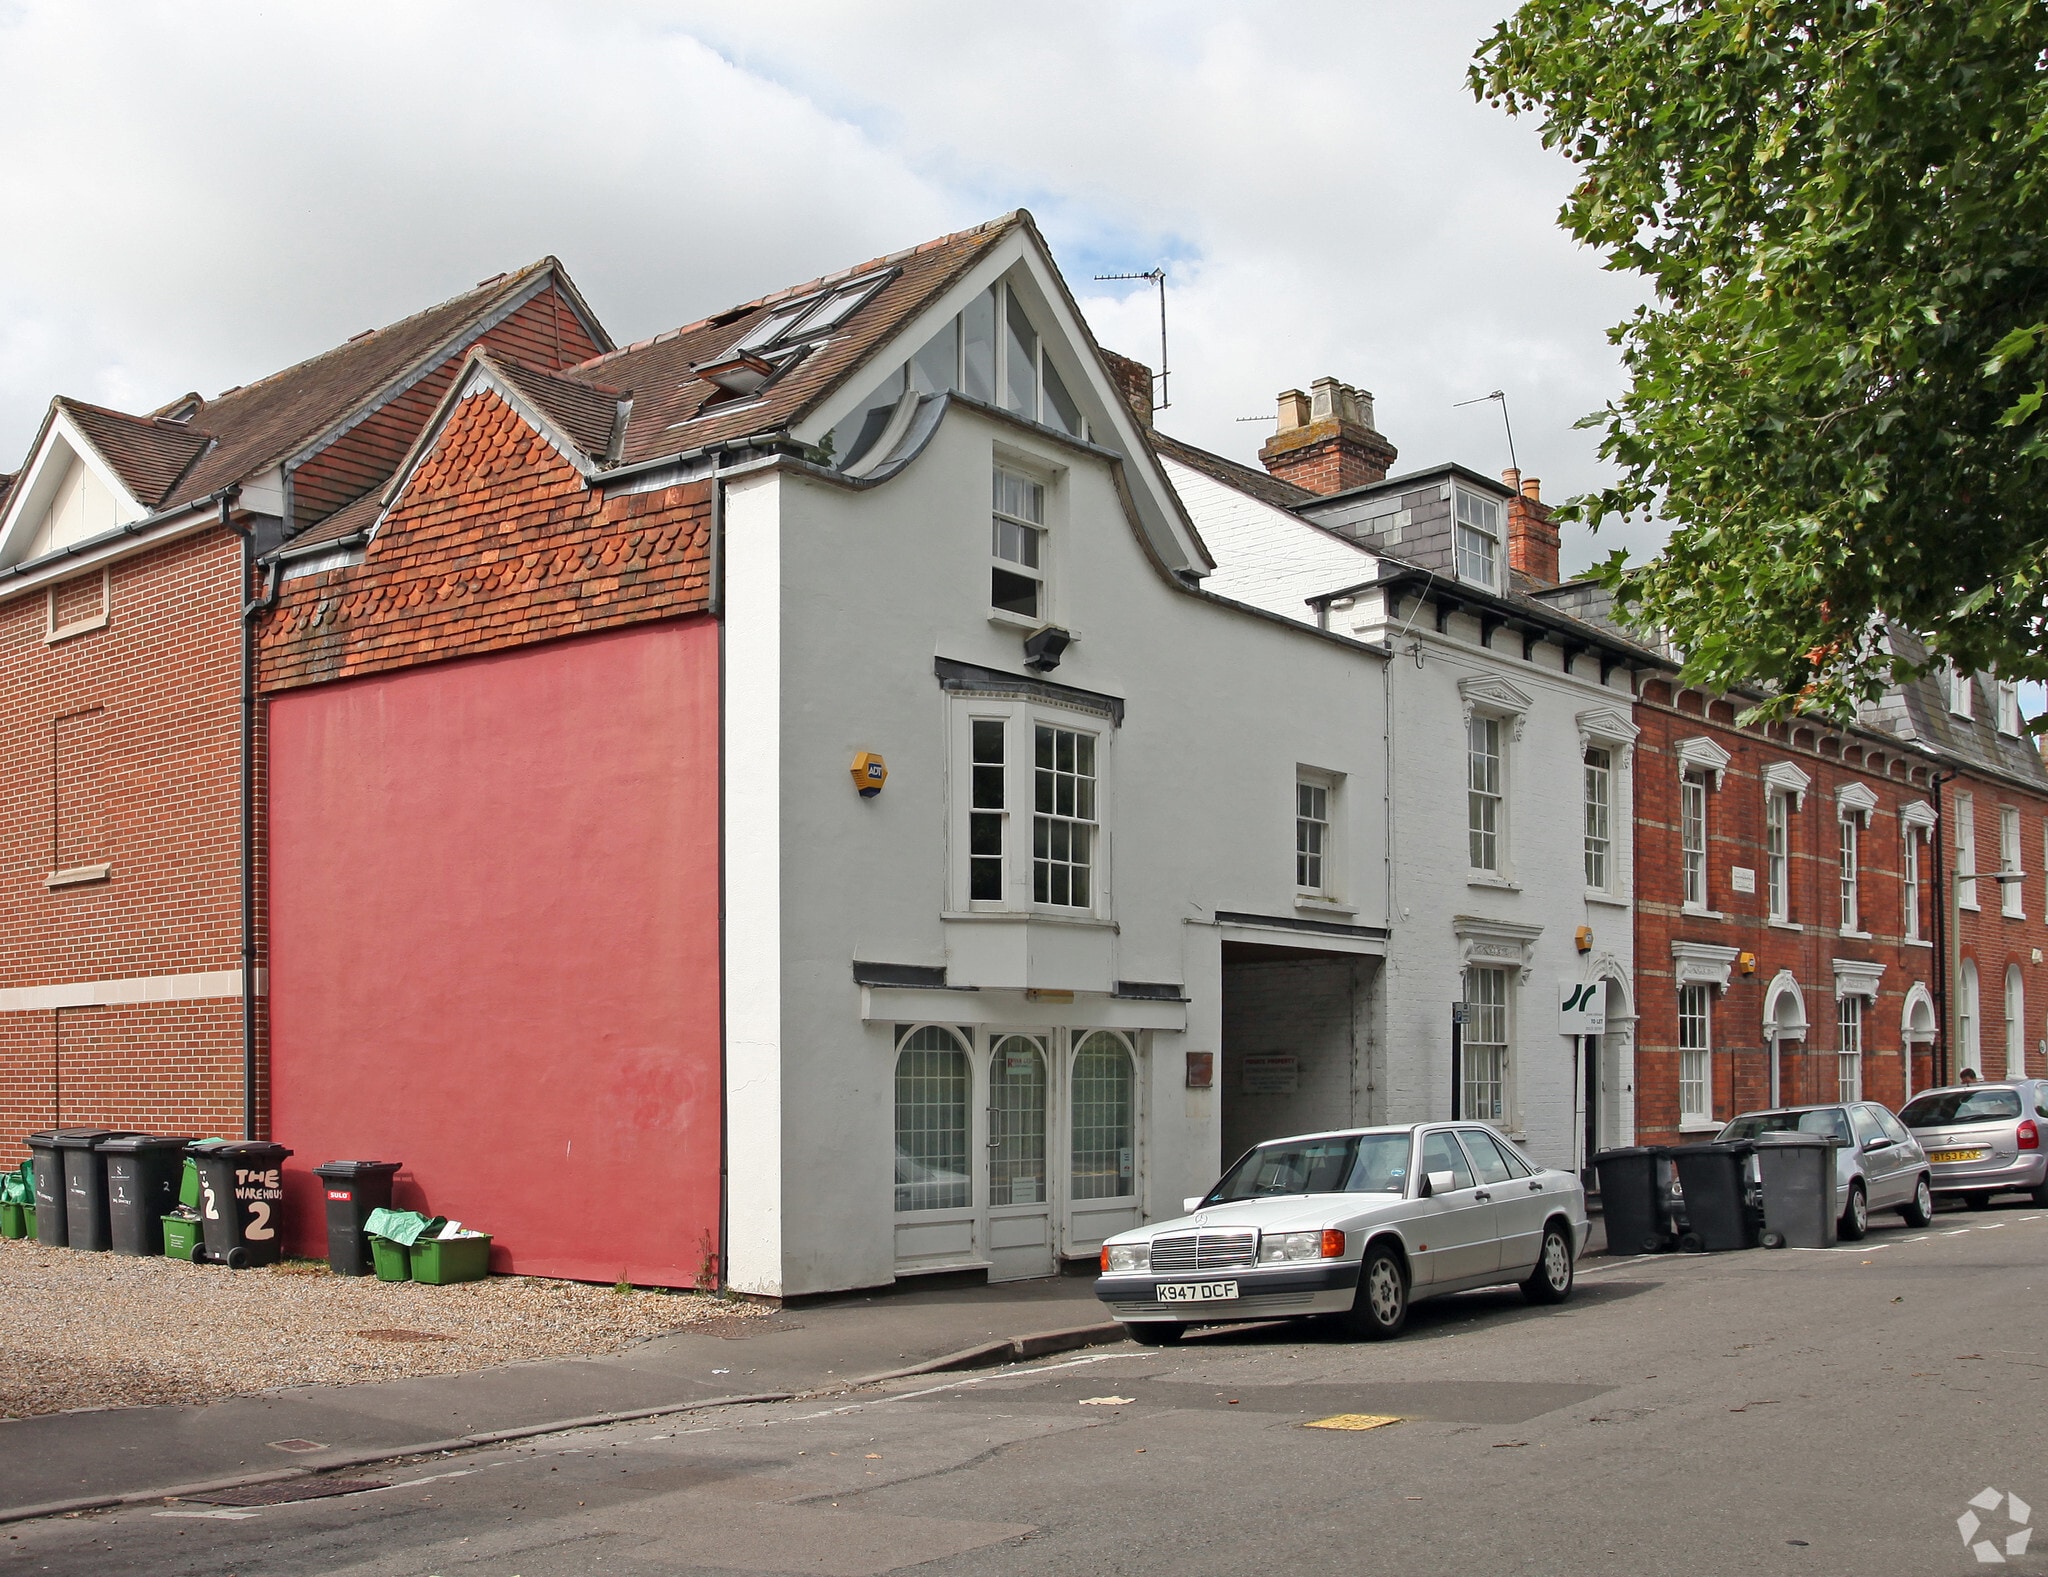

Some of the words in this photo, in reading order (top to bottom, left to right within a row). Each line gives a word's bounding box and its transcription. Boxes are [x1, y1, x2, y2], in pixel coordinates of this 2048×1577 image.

[868, 766, 882, 776] ADT
[39, 1174, 45, 1187] 3
[73, 1176, 78, 1186] 1
[235, 1169, 280, 1189] THE
[118, 1186, 125, 1198] 2
[163, 1181, 170, 1192] 2
[330, 1191, 348, 1199] SULO
[203, 1188, 220, 1220] 2
[245, 1201, 275, 1241] 2
[1158, 1285, 1197, 1301] K947
[1200, 1283, 1235, 1299] DCF
